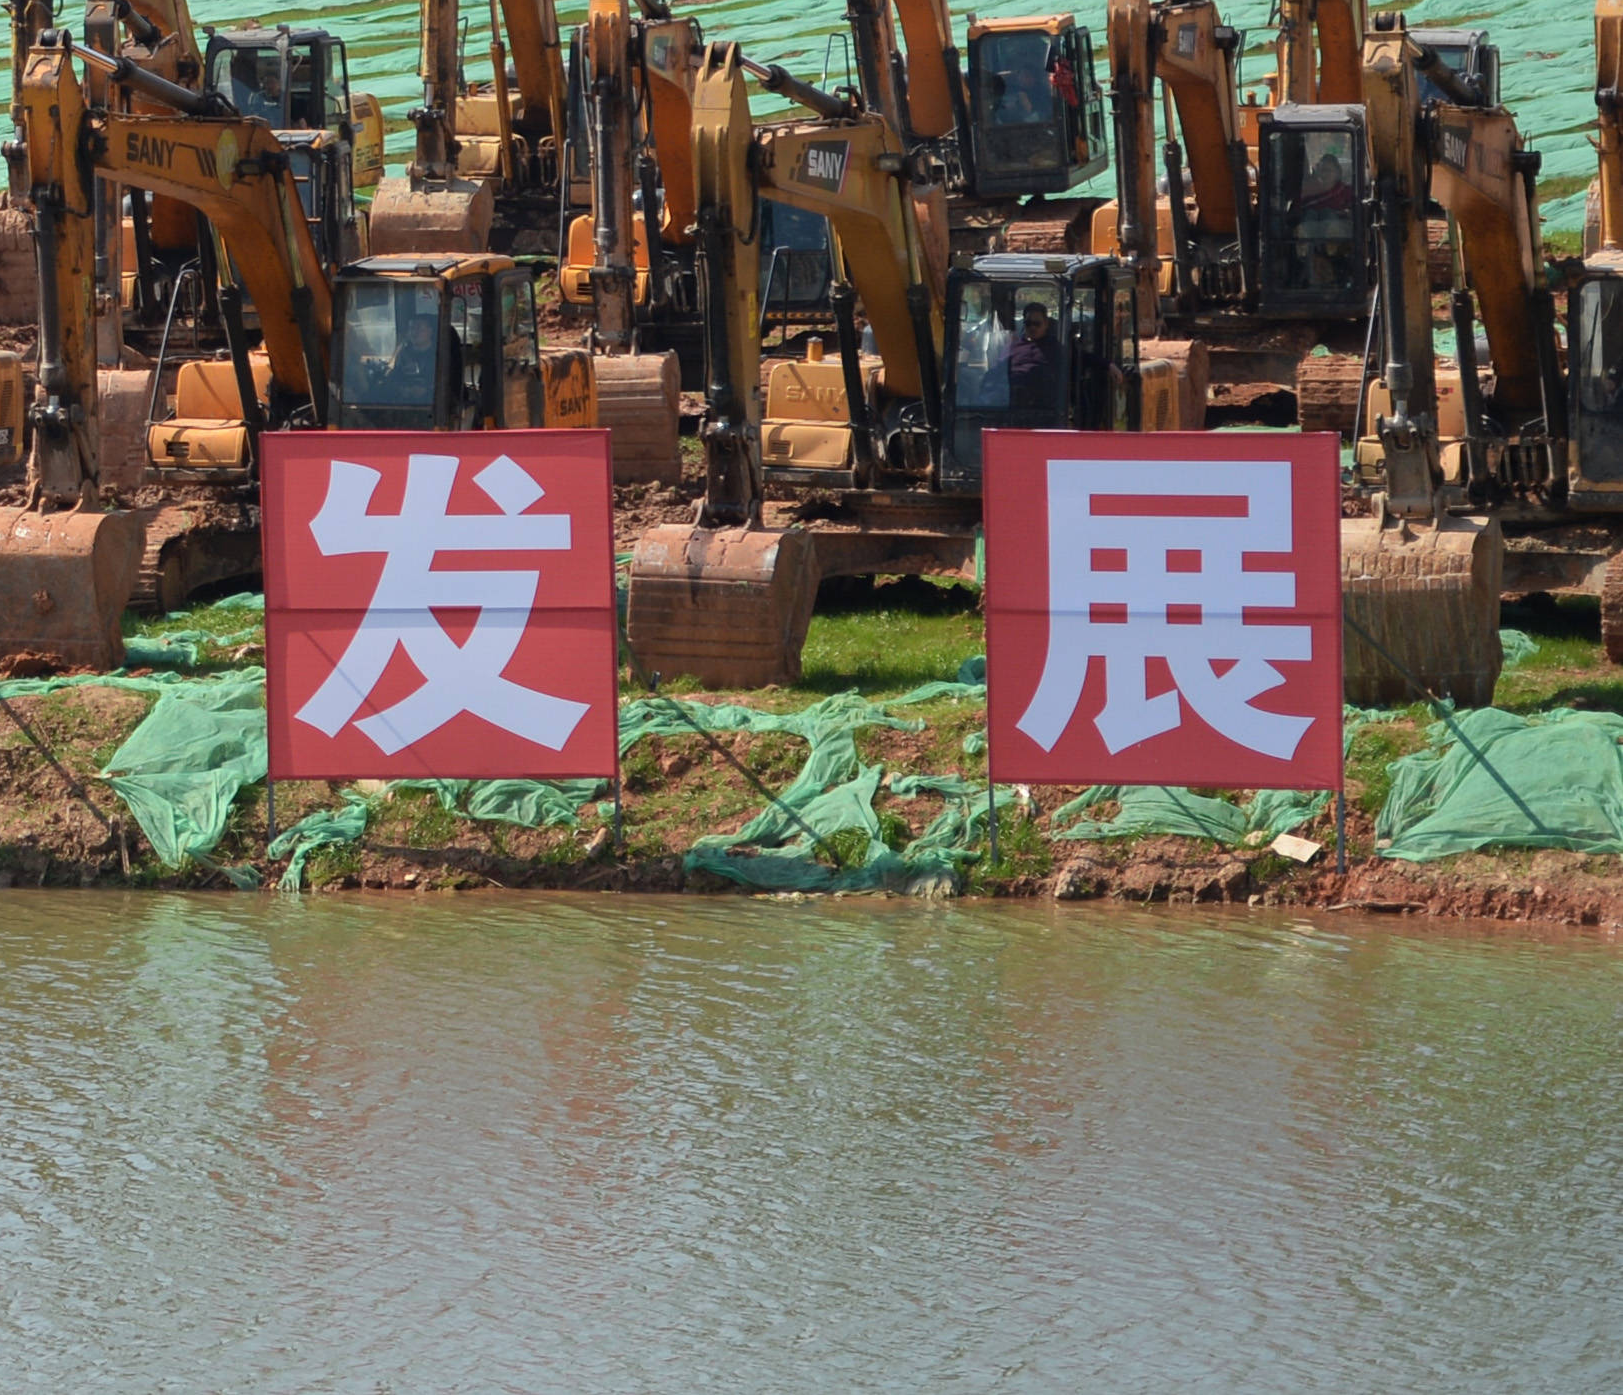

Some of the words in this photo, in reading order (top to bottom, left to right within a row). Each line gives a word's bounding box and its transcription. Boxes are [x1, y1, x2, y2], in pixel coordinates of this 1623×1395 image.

[127, 132, 176, 169] SANY
[808, 149, 843, 180] SANY
[295, 454, 590, 755] 发
[1016, 460, 1315, 760] 展
